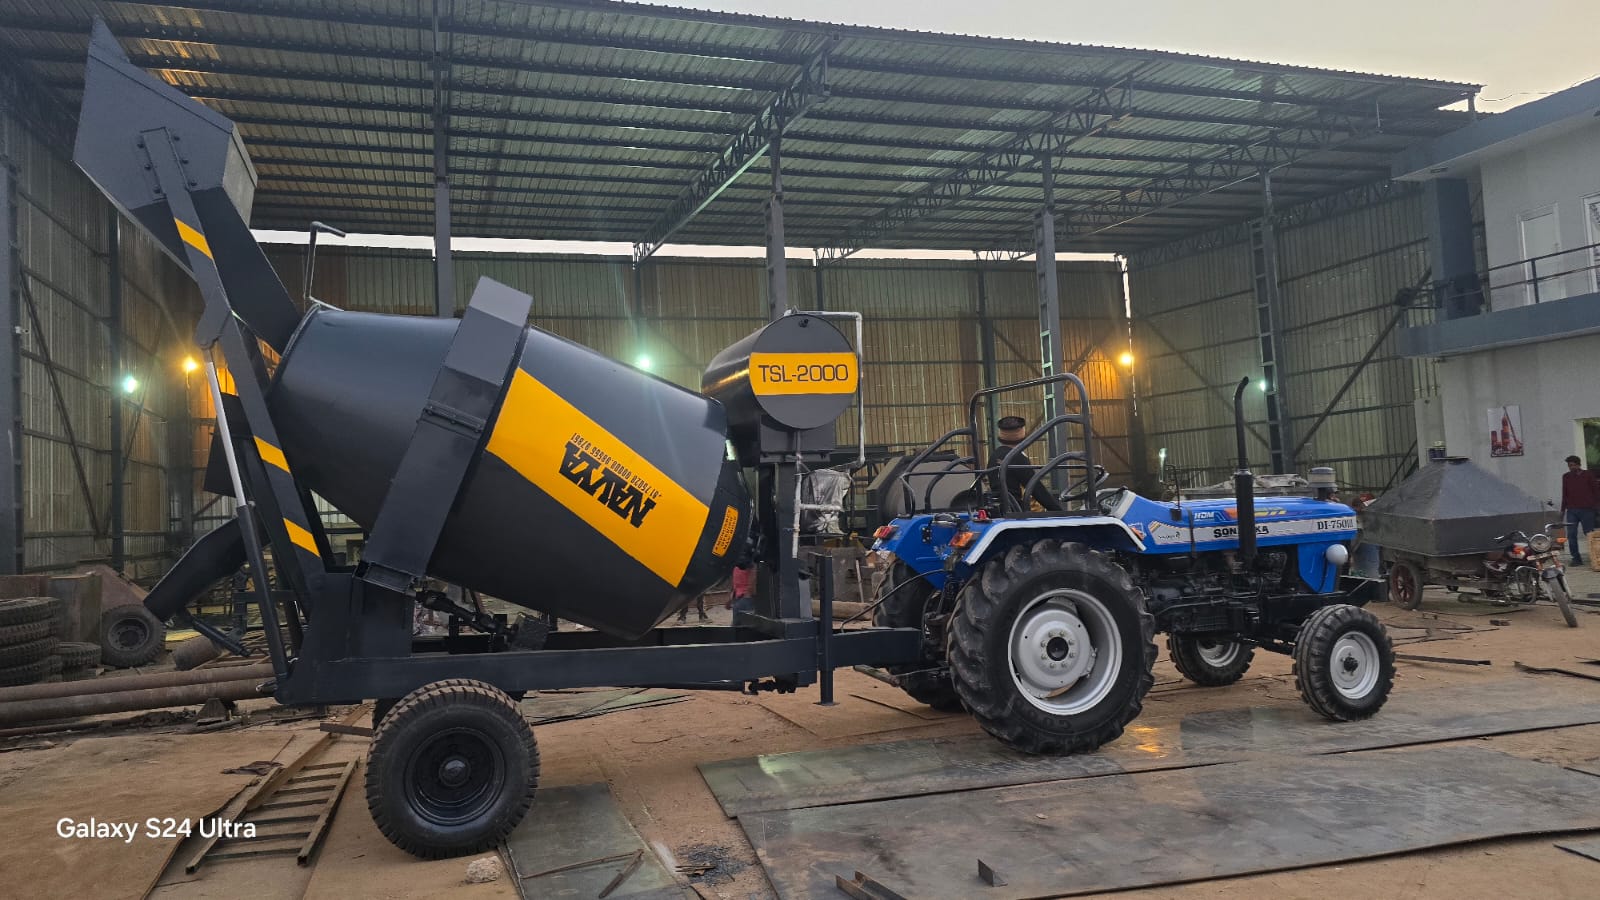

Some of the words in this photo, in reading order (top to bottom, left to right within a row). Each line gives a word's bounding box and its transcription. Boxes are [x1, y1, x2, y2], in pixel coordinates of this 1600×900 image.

[758, 364, 848, 382] TSL-2000
[559, 441, 657, 528] NAVYA
[1213, 525, 1269, 538] SONKA
